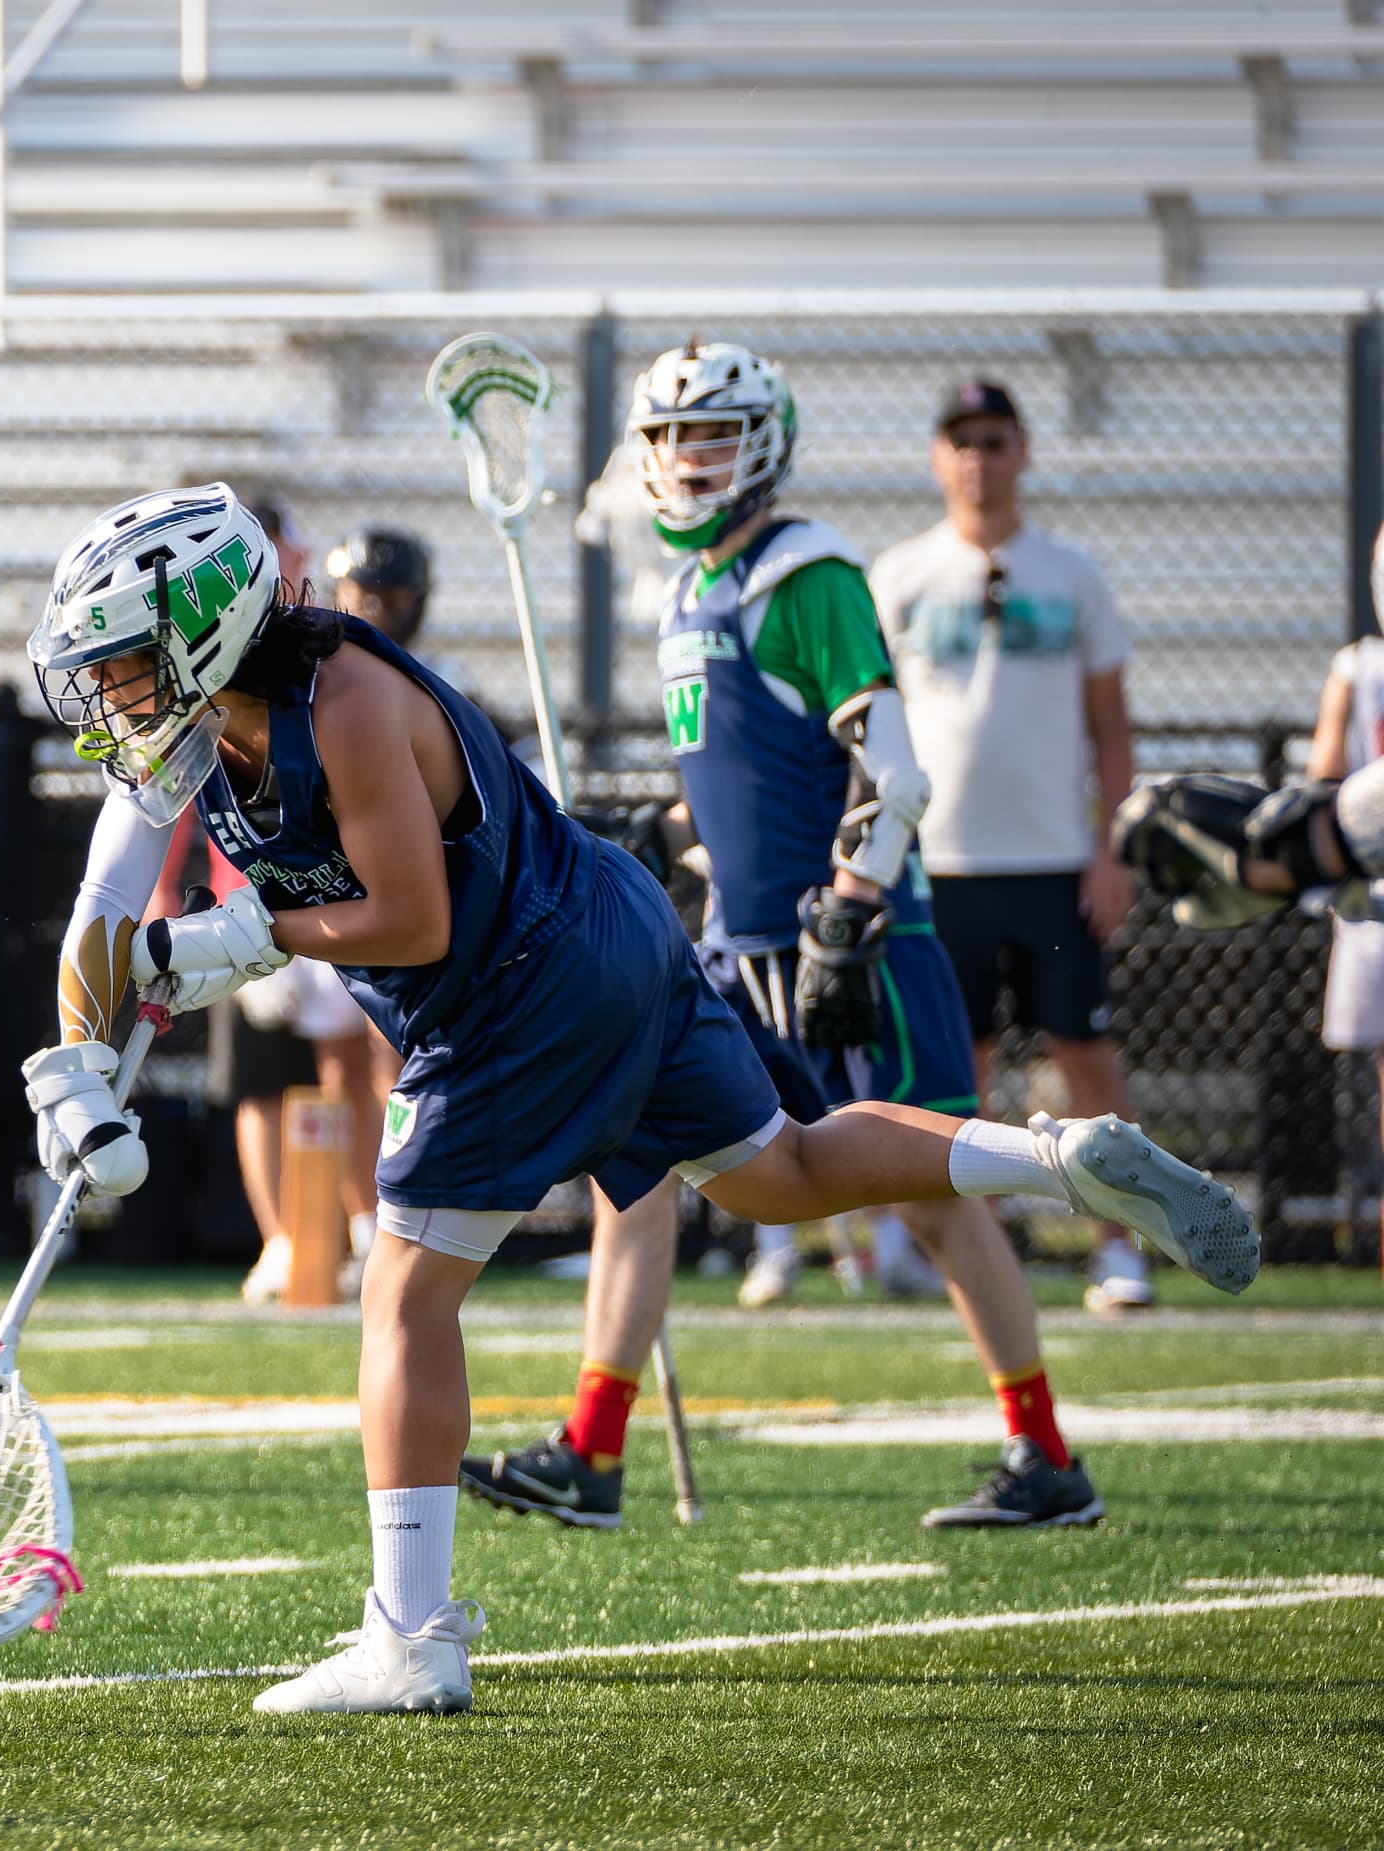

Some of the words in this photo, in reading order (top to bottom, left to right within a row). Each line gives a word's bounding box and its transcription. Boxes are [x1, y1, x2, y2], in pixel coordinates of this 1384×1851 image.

[91, 606, 107, 631] 5
[143, 534, 251, 652] W
[663, 674, 708, 755] W
